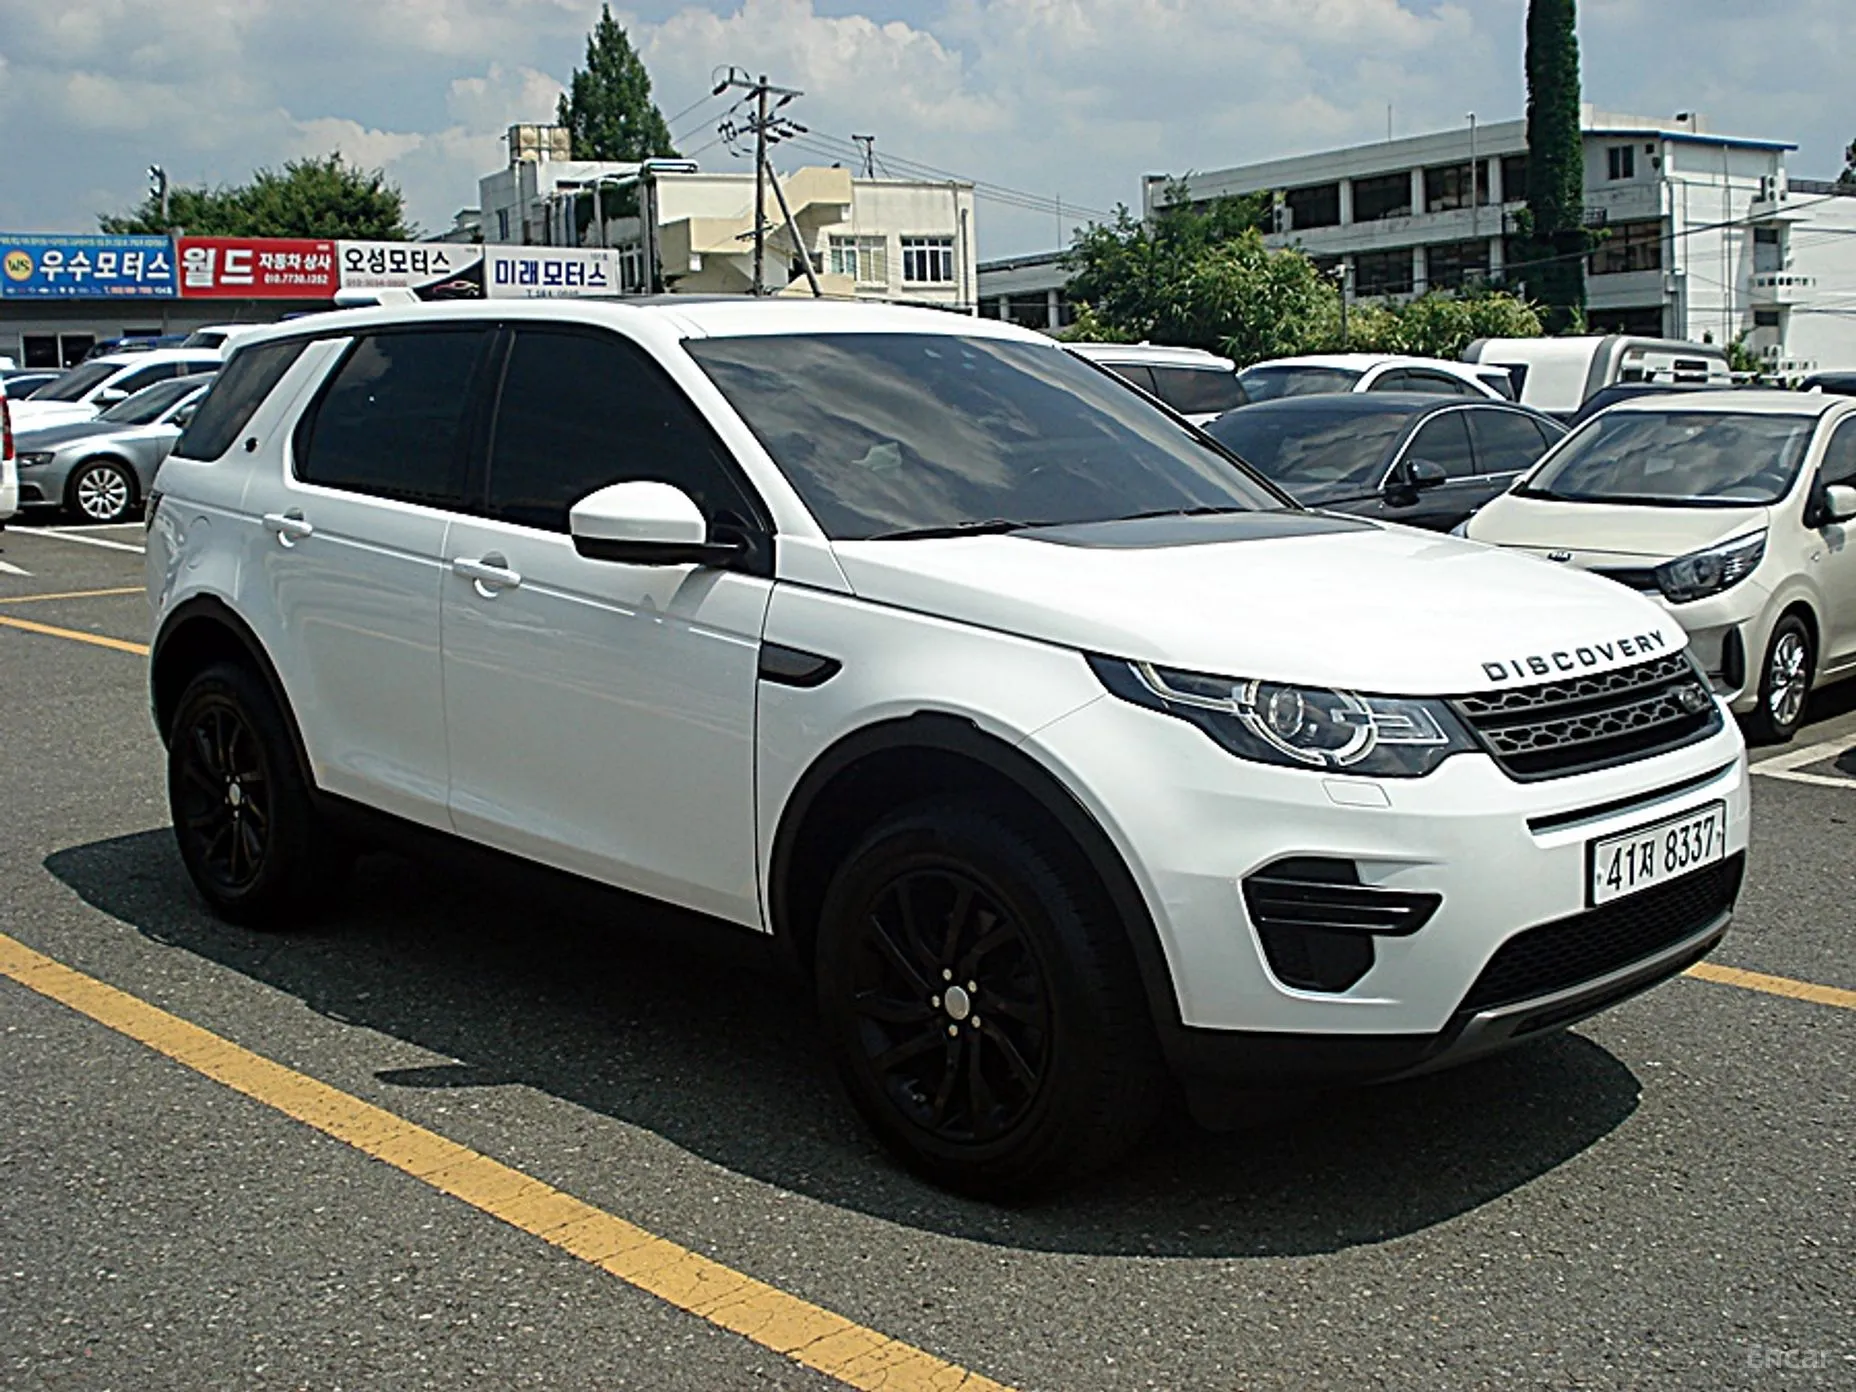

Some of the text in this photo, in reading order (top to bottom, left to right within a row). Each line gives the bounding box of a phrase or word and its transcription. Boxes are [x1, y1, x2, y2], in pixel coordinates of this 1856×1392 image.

[39, 250, 171, 282] 우수모터스
[182, 247, 254, 287] 월드
[345, 248, 451, 275] 오성모터스
[495, 259, 608, 287] 미래모터스
[1481, 630, 1666, 682] DISCOVERY
[1665, 815, 1715, 872] 8337
